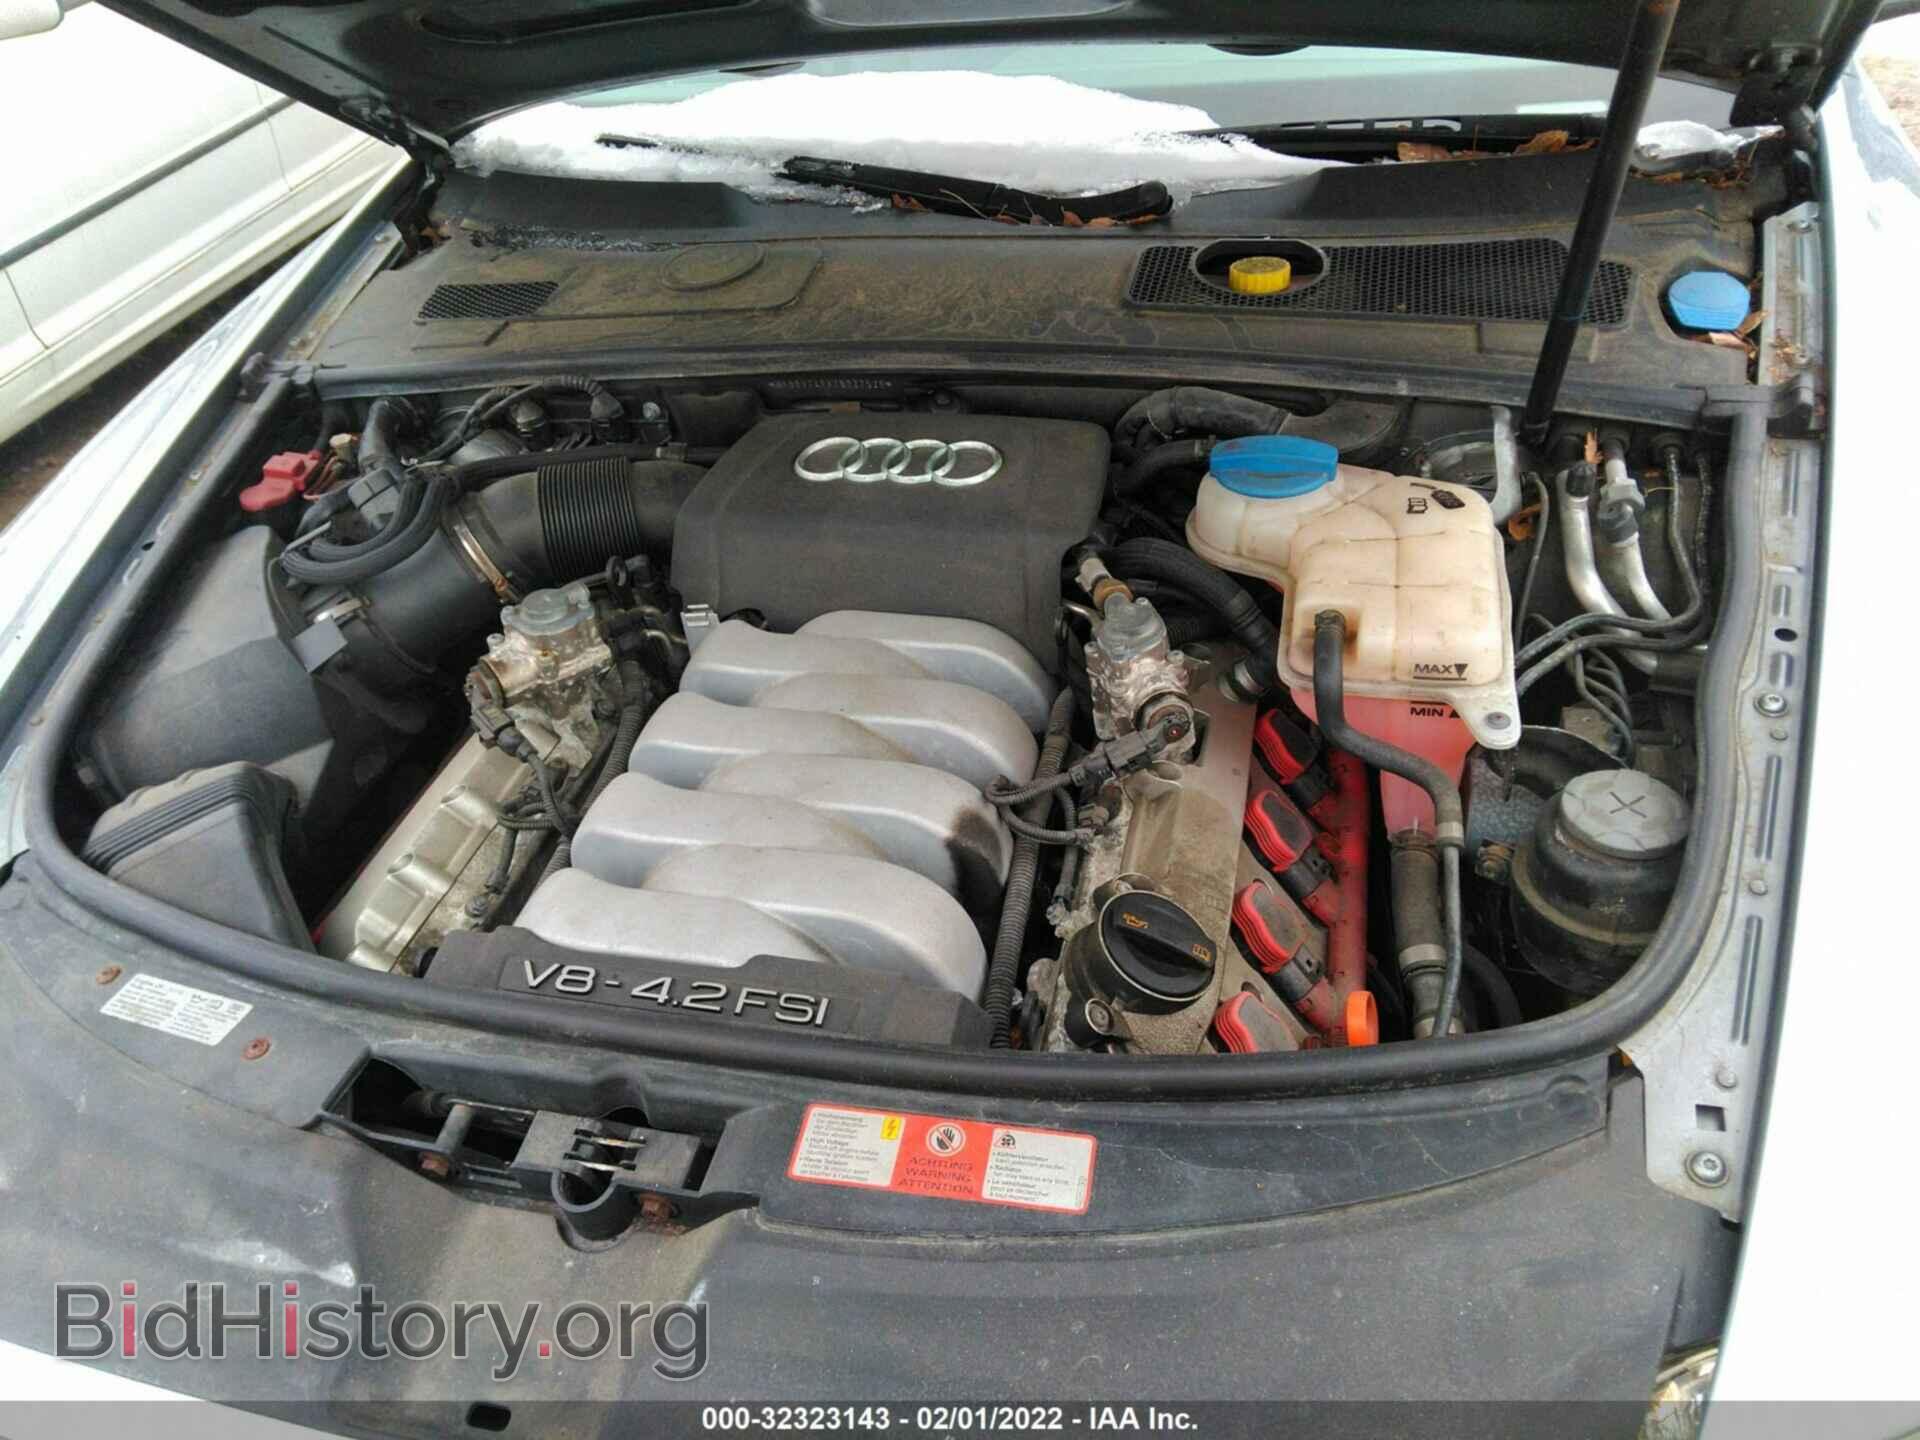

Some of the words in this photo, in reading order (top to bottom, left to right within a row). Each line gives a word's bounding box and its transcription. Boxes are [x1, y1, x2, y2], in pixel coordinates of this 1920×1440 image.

[1413, 663, 1453, 674] MAX
[1410, 706, 1444, 717] MIN
[523, 959, 597, 994] V8
[631, 976, 728, 1013] 4.2
[733, 986, 832, 1027] FSI
[910, 1157, 974, 1171] ACHTUNG
[905, 1168, 972, 1182] WARNING
[897, 1178, 974, 1193] ATTENTION
